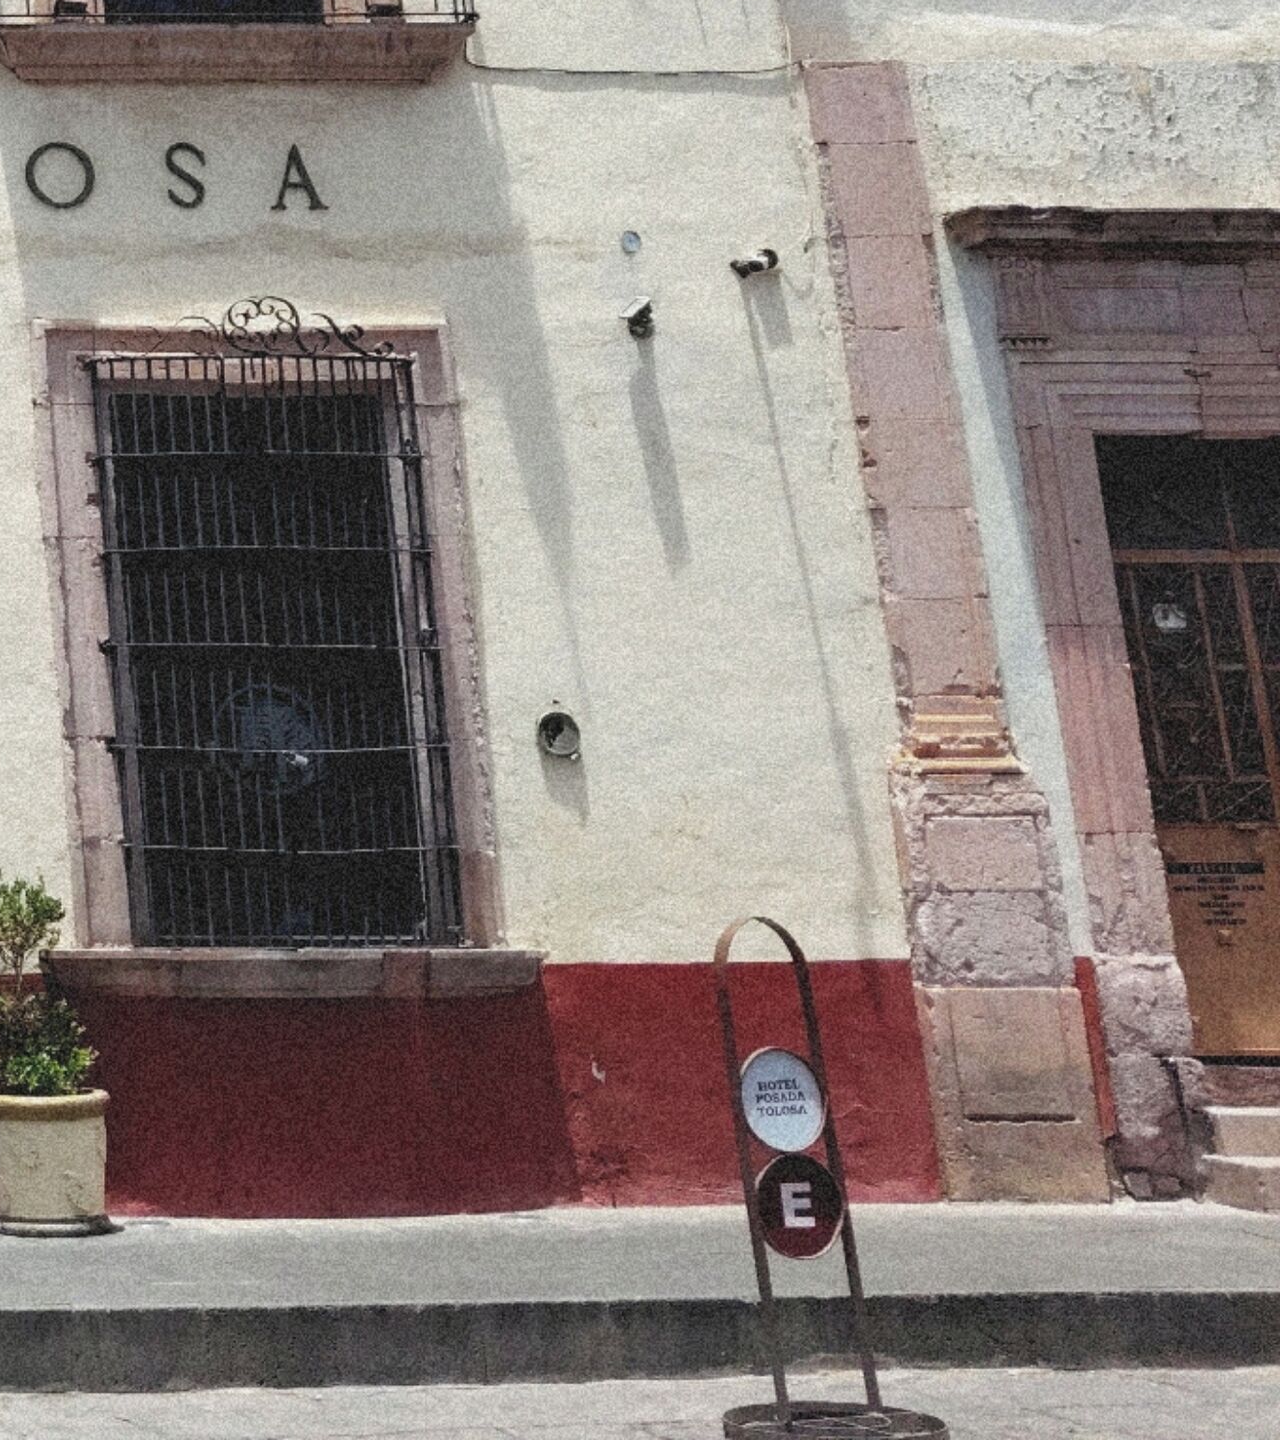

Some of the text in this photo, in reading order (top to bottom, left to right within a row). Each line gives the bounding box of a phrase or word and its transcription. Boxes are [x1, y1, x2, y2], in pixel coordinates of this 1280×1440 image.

[757, 1078, 801, 1092] HOTEL
[755, 1091, 806, 1104] POSADA
[757, 1105, 808, 1117] TOLOSA
[779, 1181, 816, 1228] E
